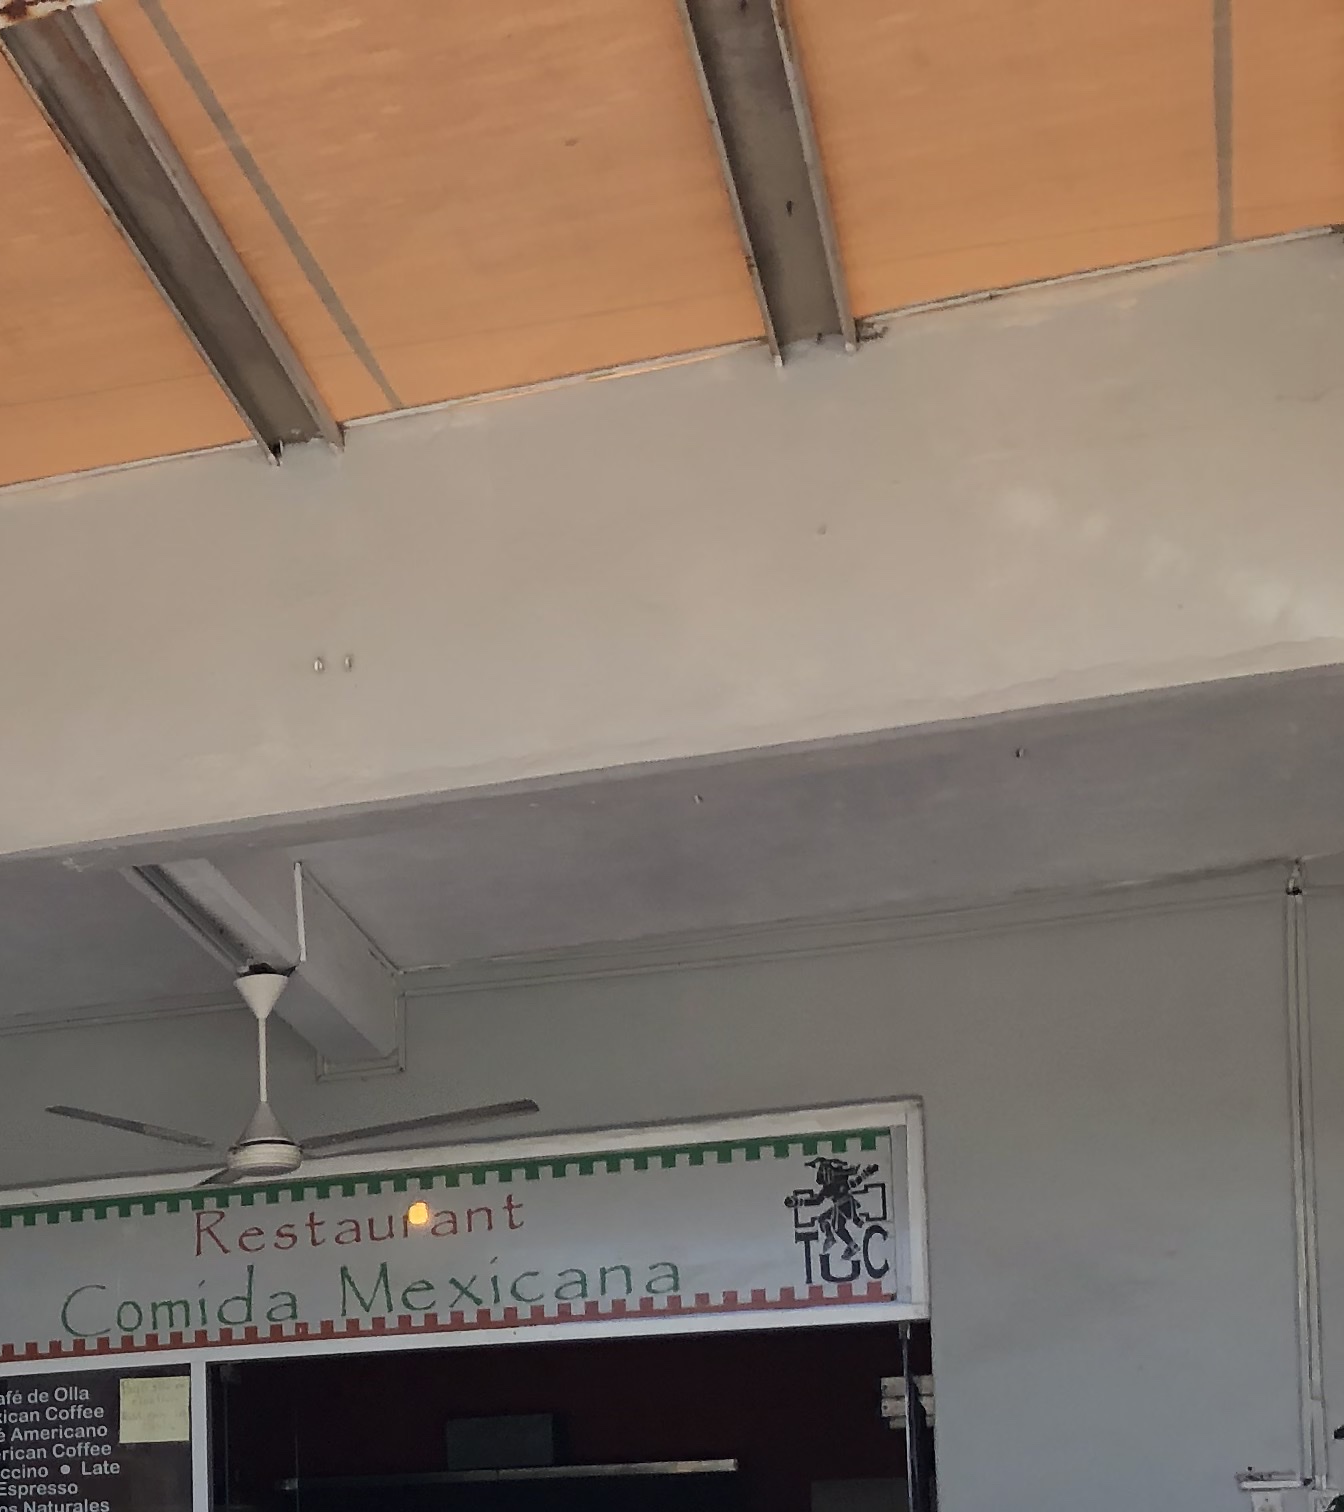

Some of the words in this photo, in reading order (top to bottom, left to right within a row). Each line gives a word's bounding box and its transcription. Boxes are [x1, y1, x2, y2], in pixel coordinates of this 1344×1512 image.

[196, 1194, 526, 1257] Restaurant
[794, 1224, 890, 1285] TUC
[60, 1265, 300, 1338] Comida
[340, 1256, 681, 1318] Mexicana
[28, 1390, 50, 1404] de
[54, 1387, 90, 1402] Olla
[46, 1406, 105, 1422] Coffee
[11, 1426, 108, 1442] Americano
[52, 1442, 112, 1459] Coffee
[81, 1460, 121, 1476] Late
